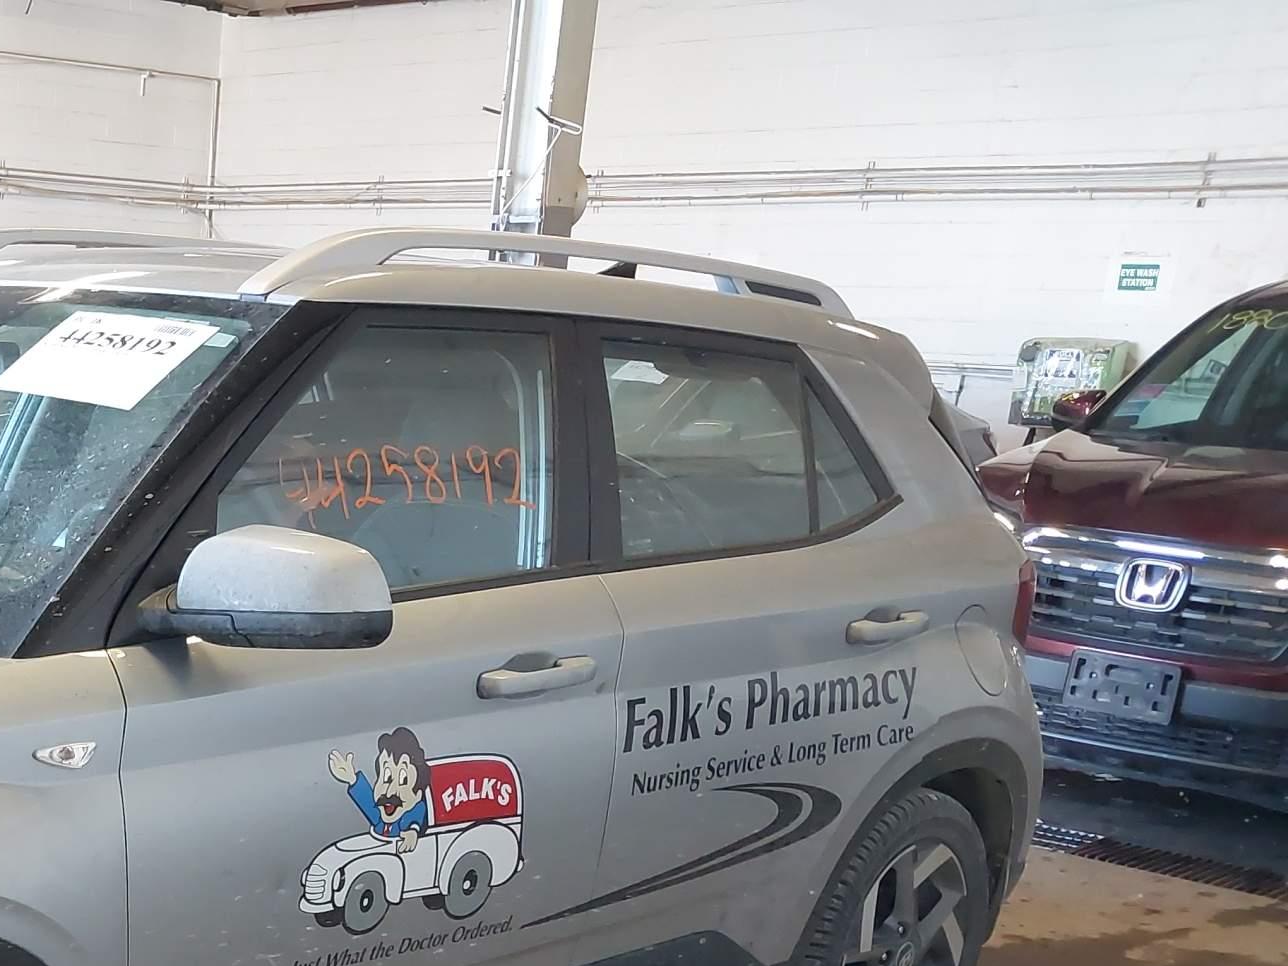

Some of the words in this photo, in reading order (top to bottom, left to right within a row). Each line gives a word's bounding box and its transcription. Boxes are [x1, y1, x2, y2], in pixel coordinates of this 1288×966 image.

[1121, 268, 1136, 277] EYE
[1137, 269, 1160, 278] WASH
[1121, 278, 1155, 287] STATION
[59, 329, 178, 356] 44258192
[279, 445, 536, 529] 44258192
[623, 684, 733, 754] Falk's
[744, 666, 918, 731] Pharmacy
[630, 763, 702, 796] Nursing
[705, 749, 765, 782] Service
[770, 745, 783, 767] &
[788, 739, 827, 766] Long
[832, 731, 872, 755] Term
[876, 723, 914, 747] Care
[441, 778, 513, 812] FALK'S
[369, 940, 395, 962] the
[397, 932, 448, 955] Doctor
[451, 914, 514, 944] Ordered.
